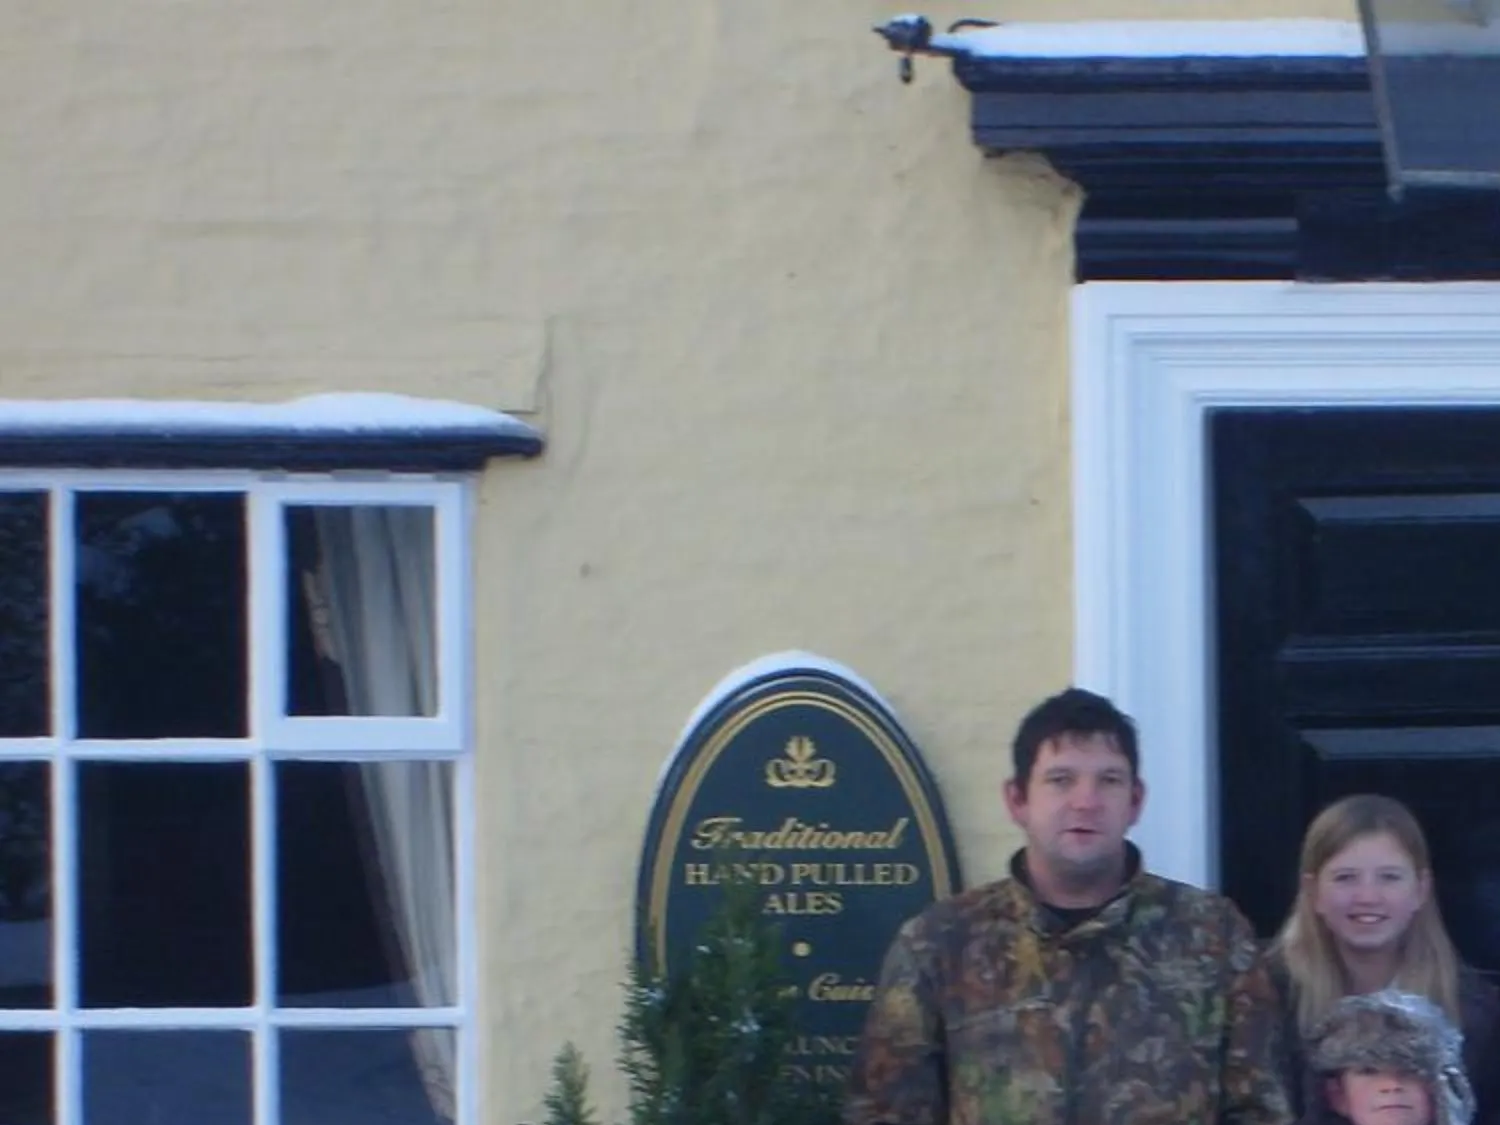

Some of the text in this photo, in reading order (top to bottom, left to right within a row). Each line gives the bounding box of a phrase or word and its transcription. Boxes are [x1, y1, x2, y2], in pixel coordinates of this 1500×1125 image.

[691, 816, 909, 849] Traditional
[791, 863, 920, 885] PULLED
[761, 891, 844, 915] ALES
